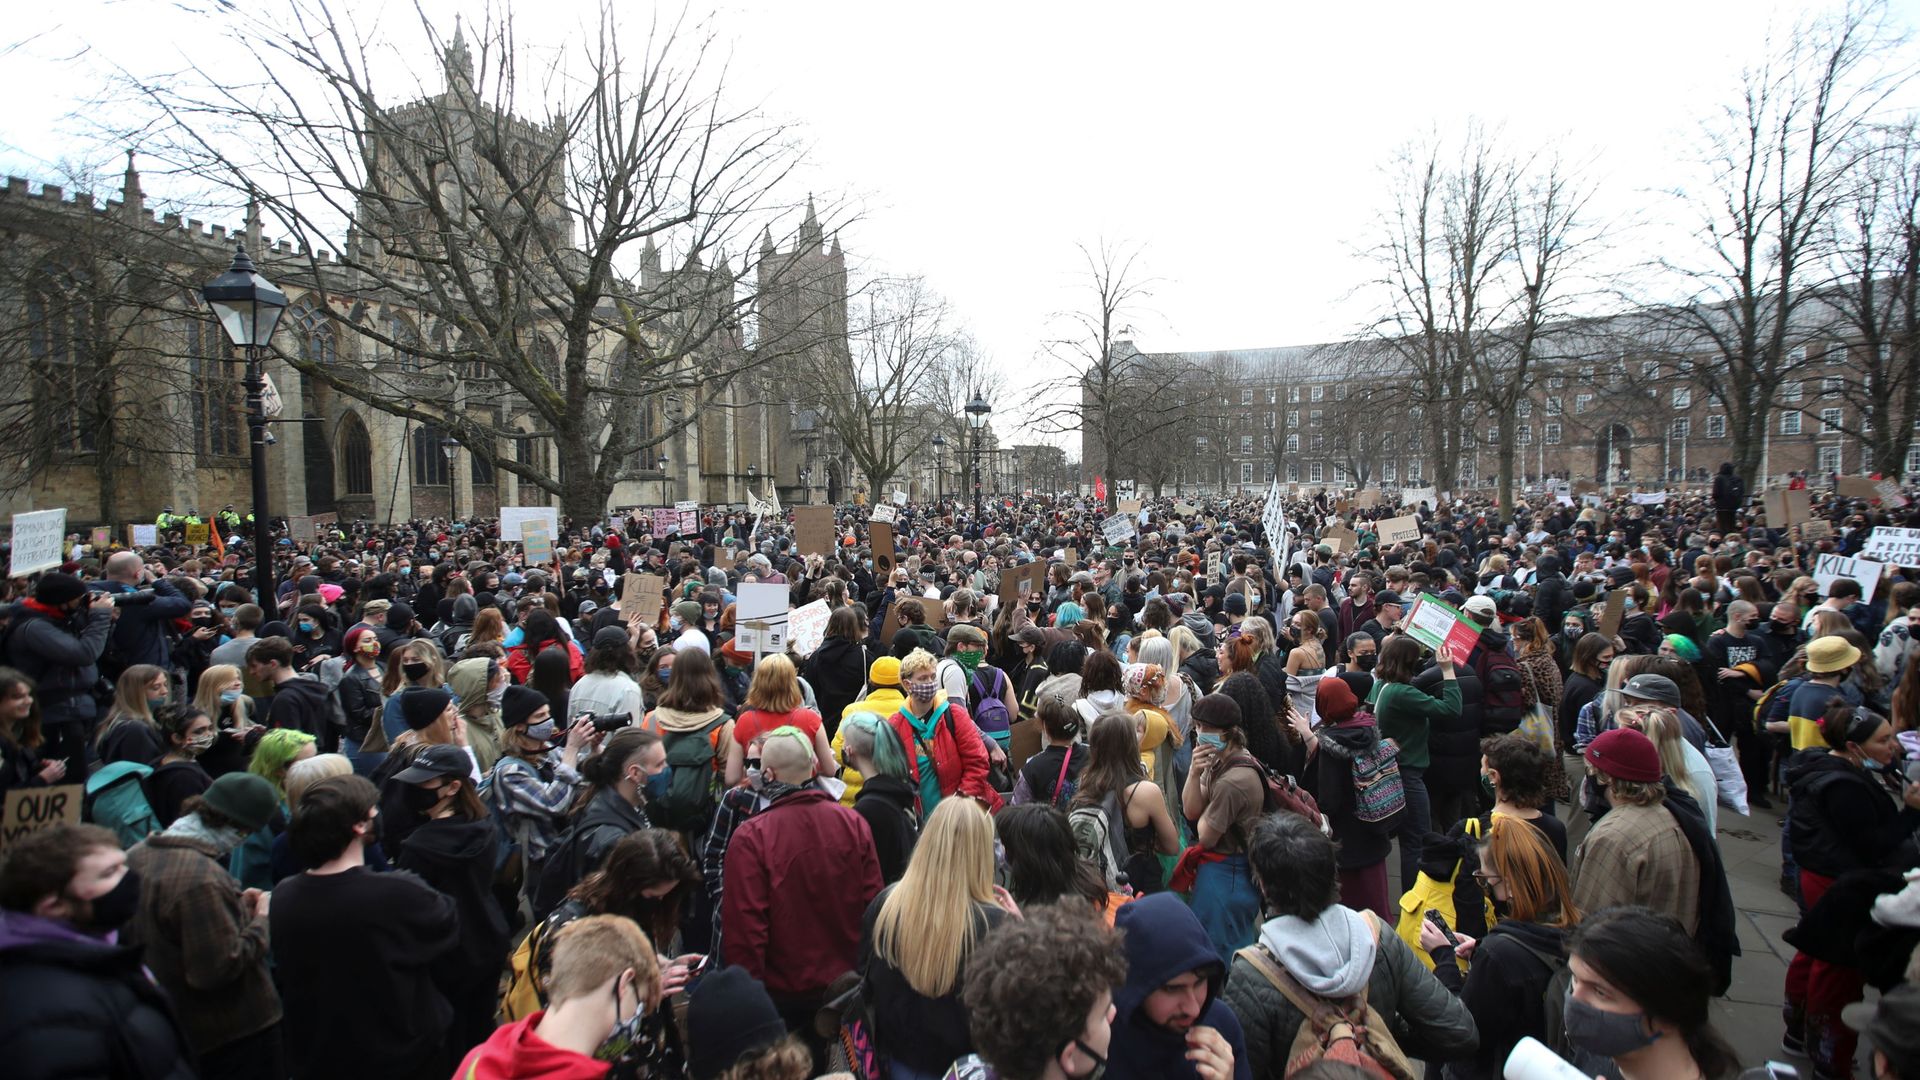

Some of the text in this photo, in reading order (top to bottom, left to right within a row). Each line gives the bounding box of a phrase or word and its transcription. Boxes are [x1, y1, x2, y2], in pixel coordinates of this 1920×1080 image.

[1392, 529, 1419, 541] PROTEST
[1876, 527, 1920, 538] THE U
[1820, 555, 1858, 578] KILL
[627, 576, 660, 595] KILL
[17, 792, 67, 823] OUR
